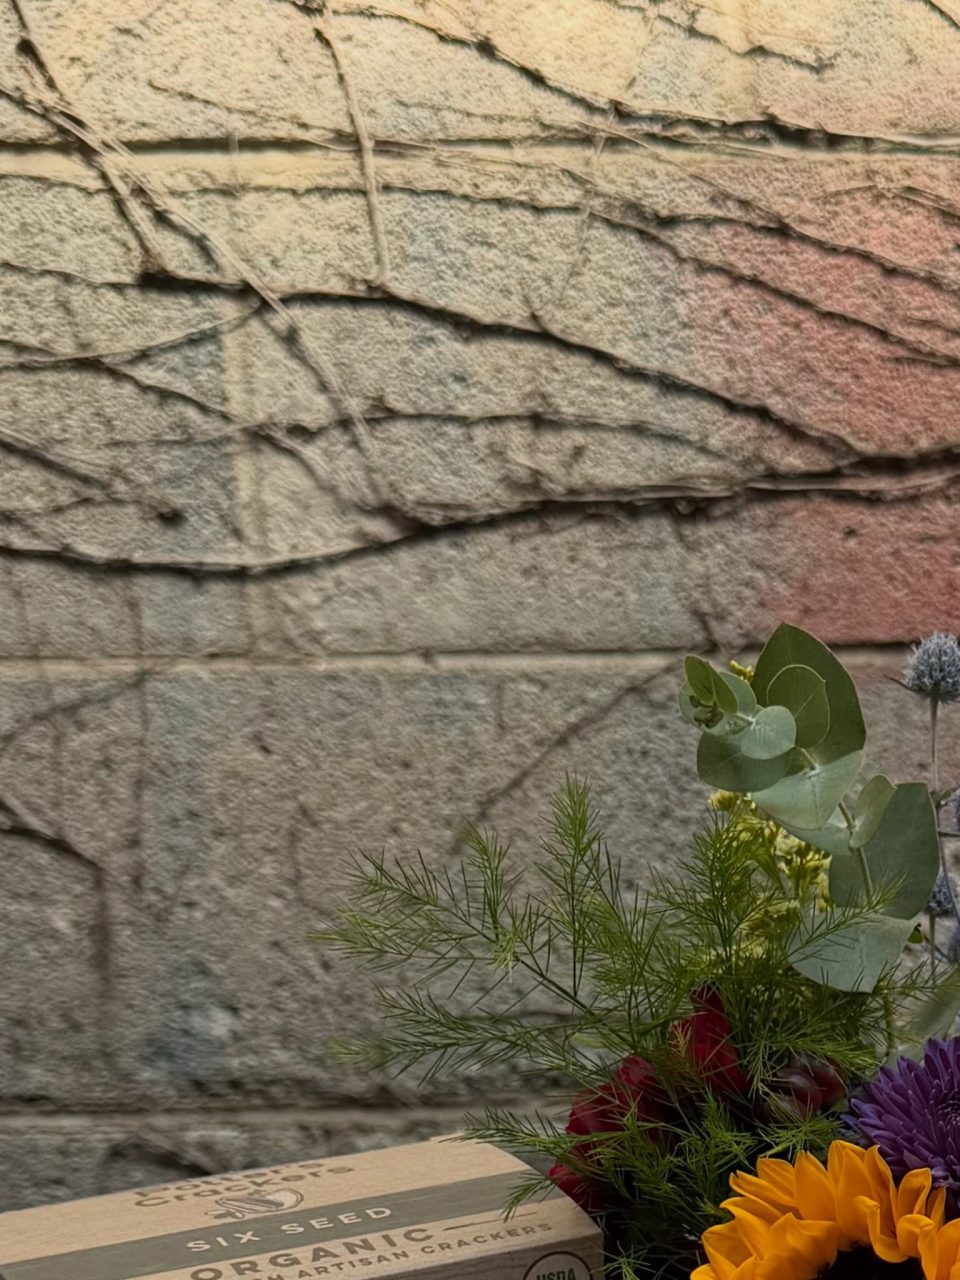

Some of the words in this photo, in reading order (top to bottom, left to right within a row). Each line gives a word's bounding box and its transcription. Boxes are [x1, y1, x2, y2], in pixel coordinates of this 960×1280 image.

[134, 1167, 354, 1207] Crackers
[186, 1230, 261, 1253] SIX
[281, 1206, 393, 1235] SEED
[297, 1250, 409, 1279] ARTISAN
[421, 1222, 553, 1254] CRACKERS
